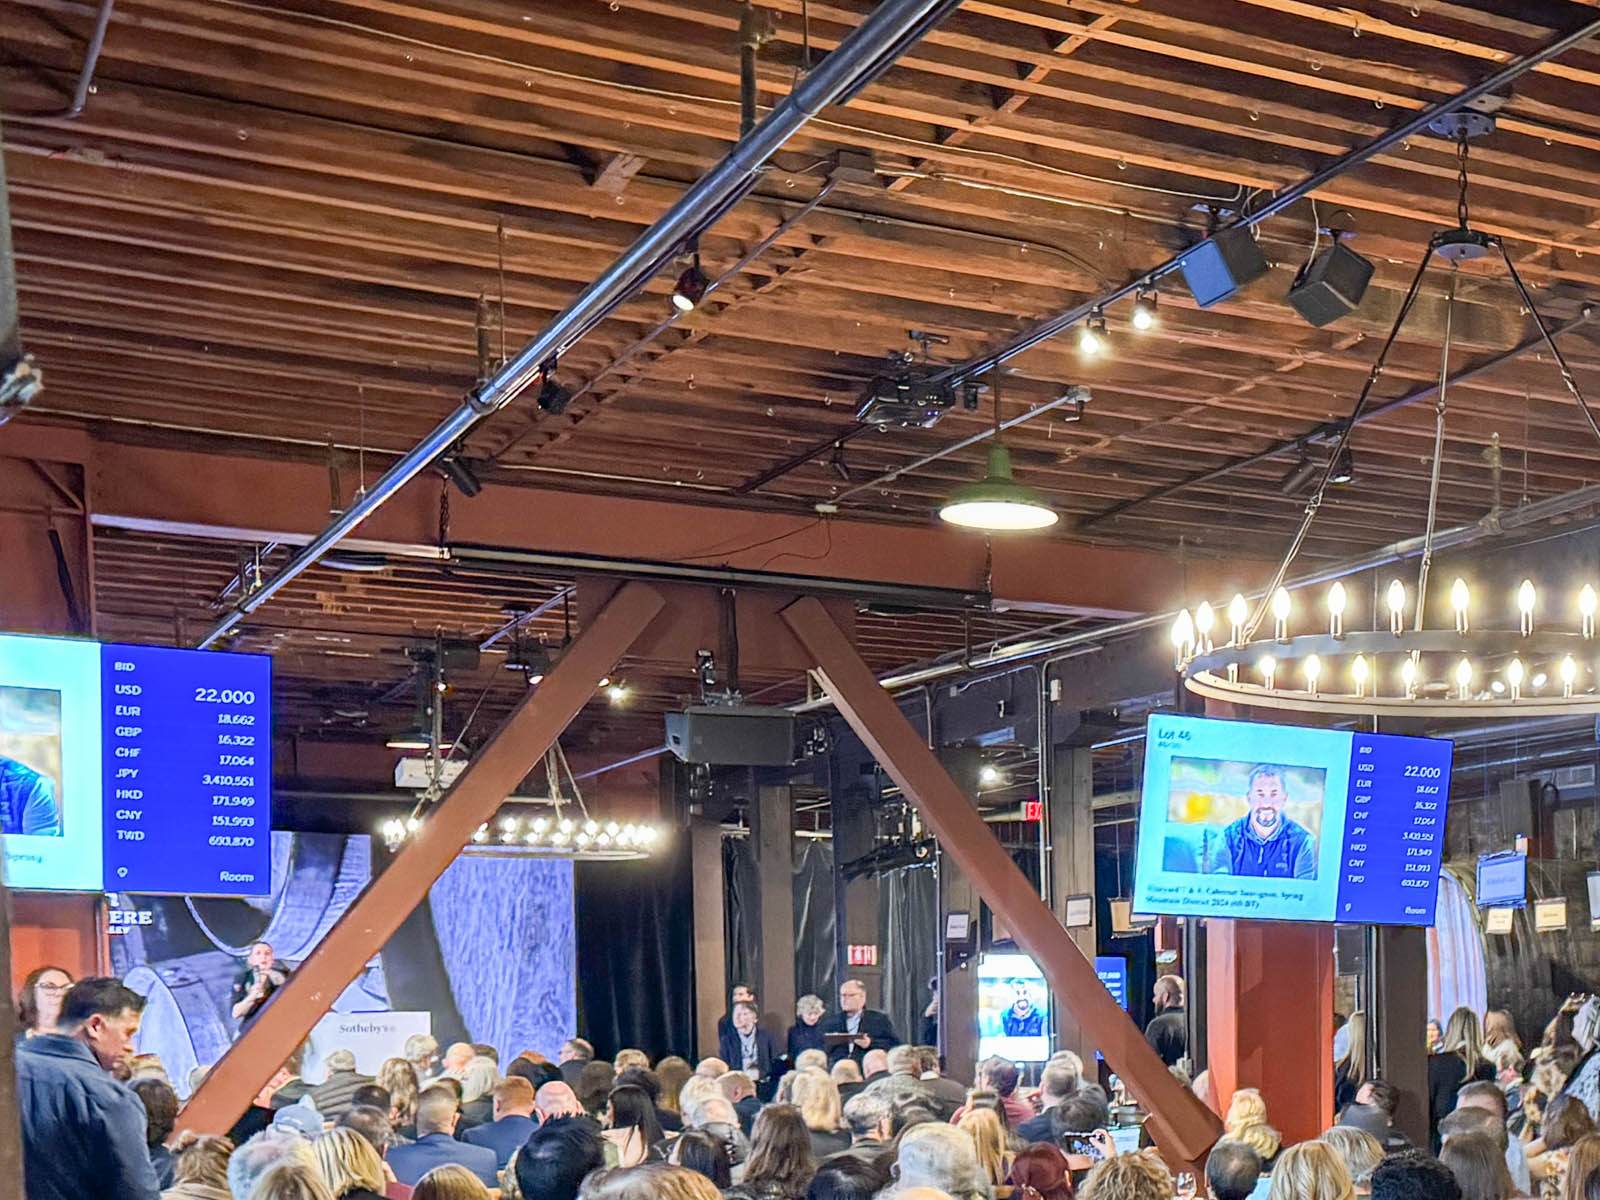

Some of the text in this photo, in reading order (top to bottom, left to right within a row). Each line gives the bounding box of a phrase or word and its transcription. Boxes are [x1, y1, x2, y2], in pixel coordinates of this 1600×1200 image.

[114, 661, 136, 672] BID
[114, 684, 143, 696] USD
[115, 704, 141, 717] EUR
[114, 725, 143, 737] GBP
[114, 746, 142, 758] CHF
[115, 768, 139, 779] JPY
[115, 788, 144, 800] HKD
[115, 809, 143, 821] CNY
[116, 829, 146, 841] TWD
[219, 870, 255, 883] Room
